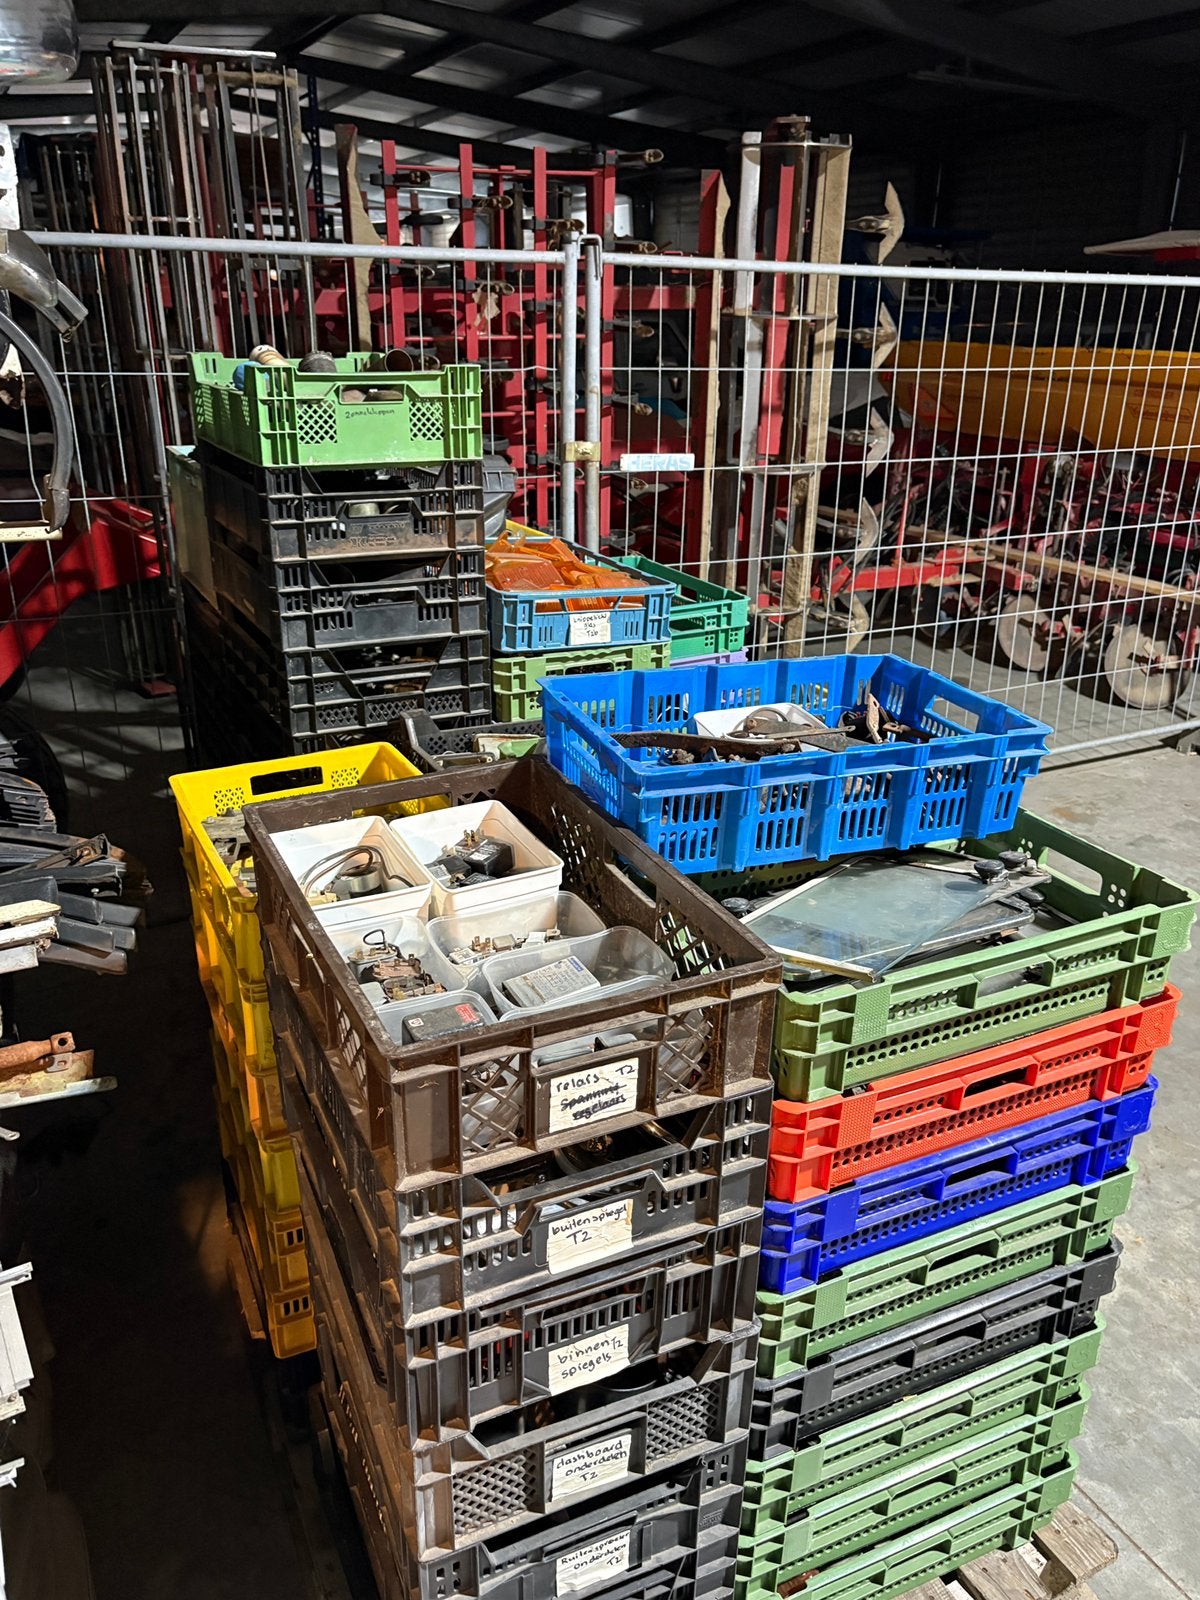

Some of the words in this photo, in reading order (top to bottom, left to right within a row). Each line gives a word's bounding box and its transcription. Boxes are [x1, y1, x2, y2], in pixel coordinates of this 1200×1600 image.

[627, 455, 691, 471] HERAS
[615, 1064, 635, 1076] T2
[566, 1230, 592, 1245] T2
[557, 1340, 610, 1364] binnen
[611, 1336, 624, 1350] T2
[561, 1352, 611, 1379] spiegels
[556, 1440, 623, 1469] dashboard
[565, 1450, 627, 1477] onderdelen
[580, 1471, 598, 1481] T2
[606, 1556, 622, 1566] T2
